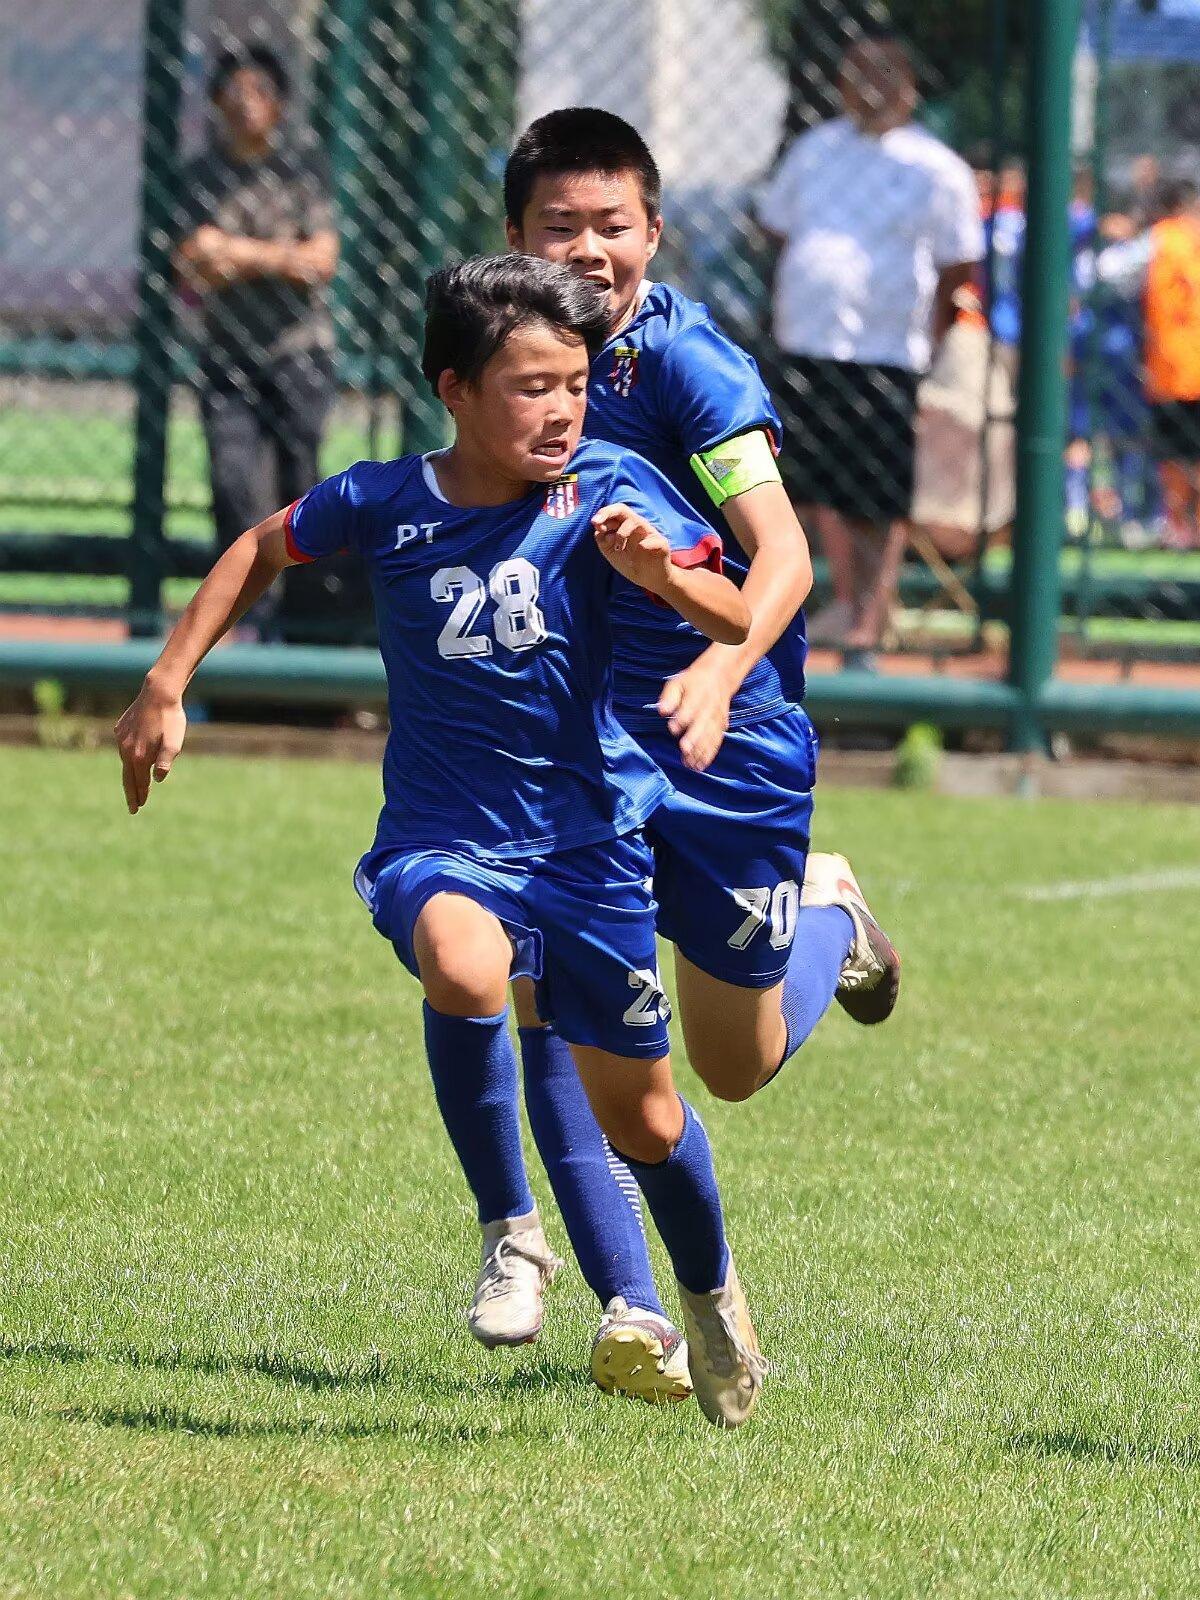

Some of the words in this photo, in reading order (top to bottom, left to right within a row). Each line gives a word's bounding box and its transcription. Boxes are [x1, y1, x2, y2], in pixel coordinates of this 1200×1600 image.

[395, 521, 443, 550] PT
[430, 557, 549, 660] 28
[727, 879, 800, 951] 70
